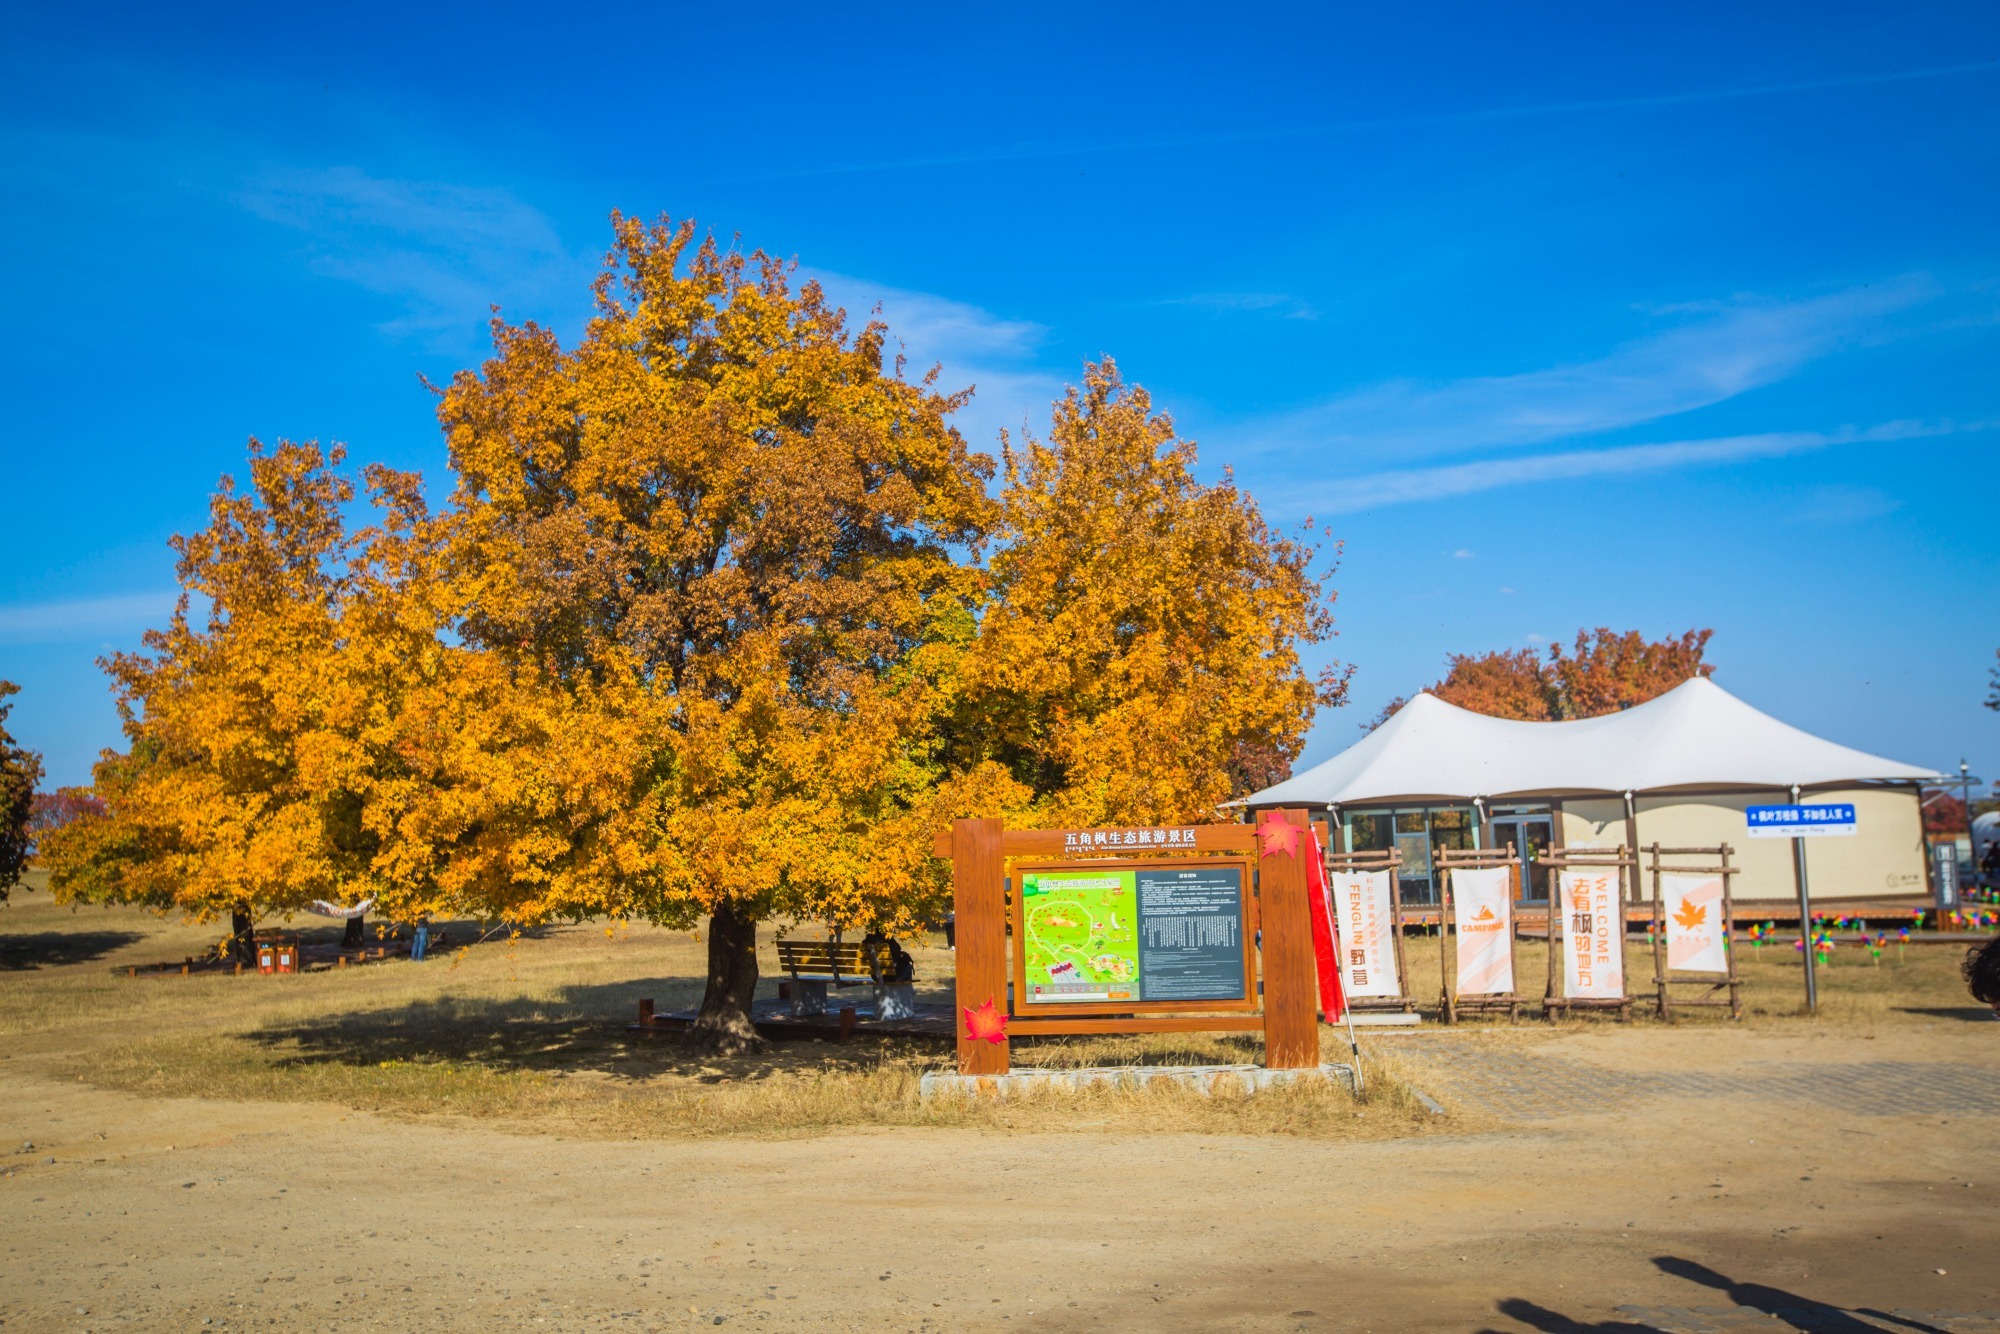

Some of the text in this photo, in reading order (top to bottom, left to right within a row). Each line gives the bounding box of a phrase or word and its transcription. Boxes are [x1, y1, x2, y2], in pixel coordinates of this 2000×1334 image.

[1064, 829, 1197, 846] 五角枫生态旅游景区
[1349, 884, 1364, 946] FENGLIN
[1461, 922, 1505, 933] CAMPING
[1571, 878, 1593, 988] 去有枫的地方
[1595, 877, 1610, 964] WELCOME
